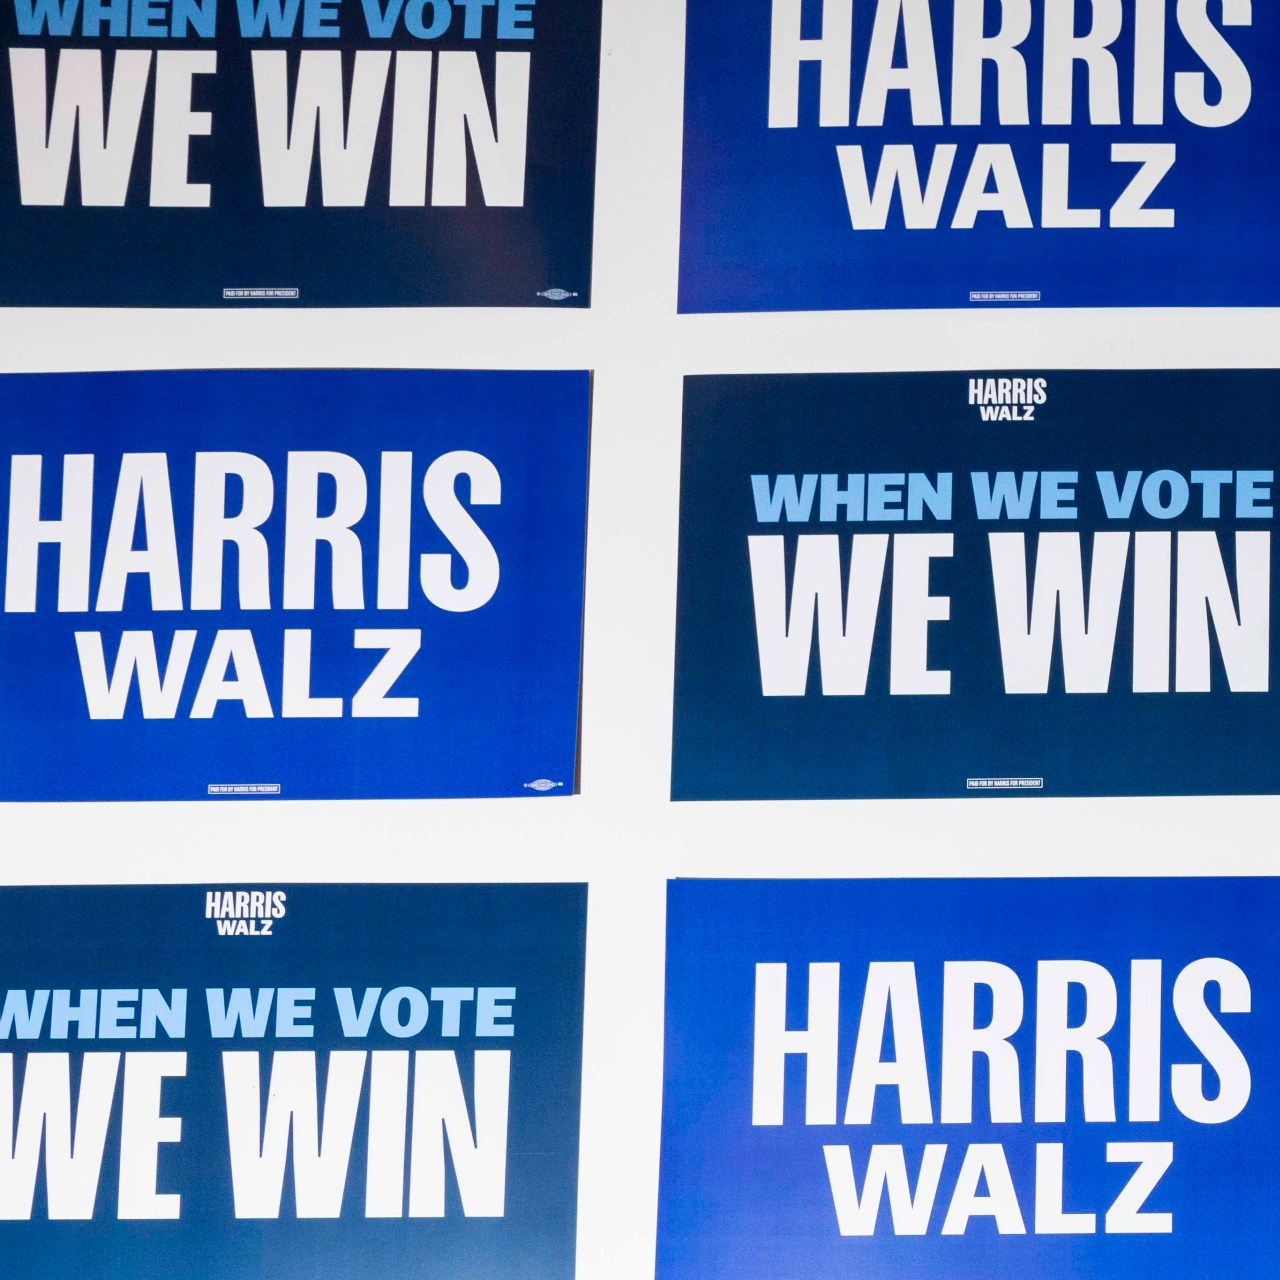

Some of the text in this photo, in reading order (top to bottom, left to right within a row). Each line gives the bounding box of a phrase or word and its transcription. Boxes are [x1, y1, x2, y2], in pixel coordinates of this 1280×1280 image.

[14, 0, 535, 39] WHEN WE VOTE
[768, 0, 1252, 128] HARRIS
[9, 48, 530, 207] WE WIN
[836, 144, 1176, 230] WALZ
[968, 377, 1047, 405] HARRIS
[979, 405, 1035, 421] WALZ
[5, 451, 501, 612] HARRIS
[751, 470, 1273, 522] WHEN WE VOTE
[748, 531, 1270, 696] WE WIN
[75, 629, 421, 719] WALZ
[205, 891, 286, 918] HARRIS
[216, 919, 272, 936] WALZ
[0, 987, 516, 1039] WHEN WE VOTE
[752, 958, 1251, 1125] HARRIS
[0, 1050, 510, 1220] WE WIN
[823, 1142, 1173, 1236] WALZ
